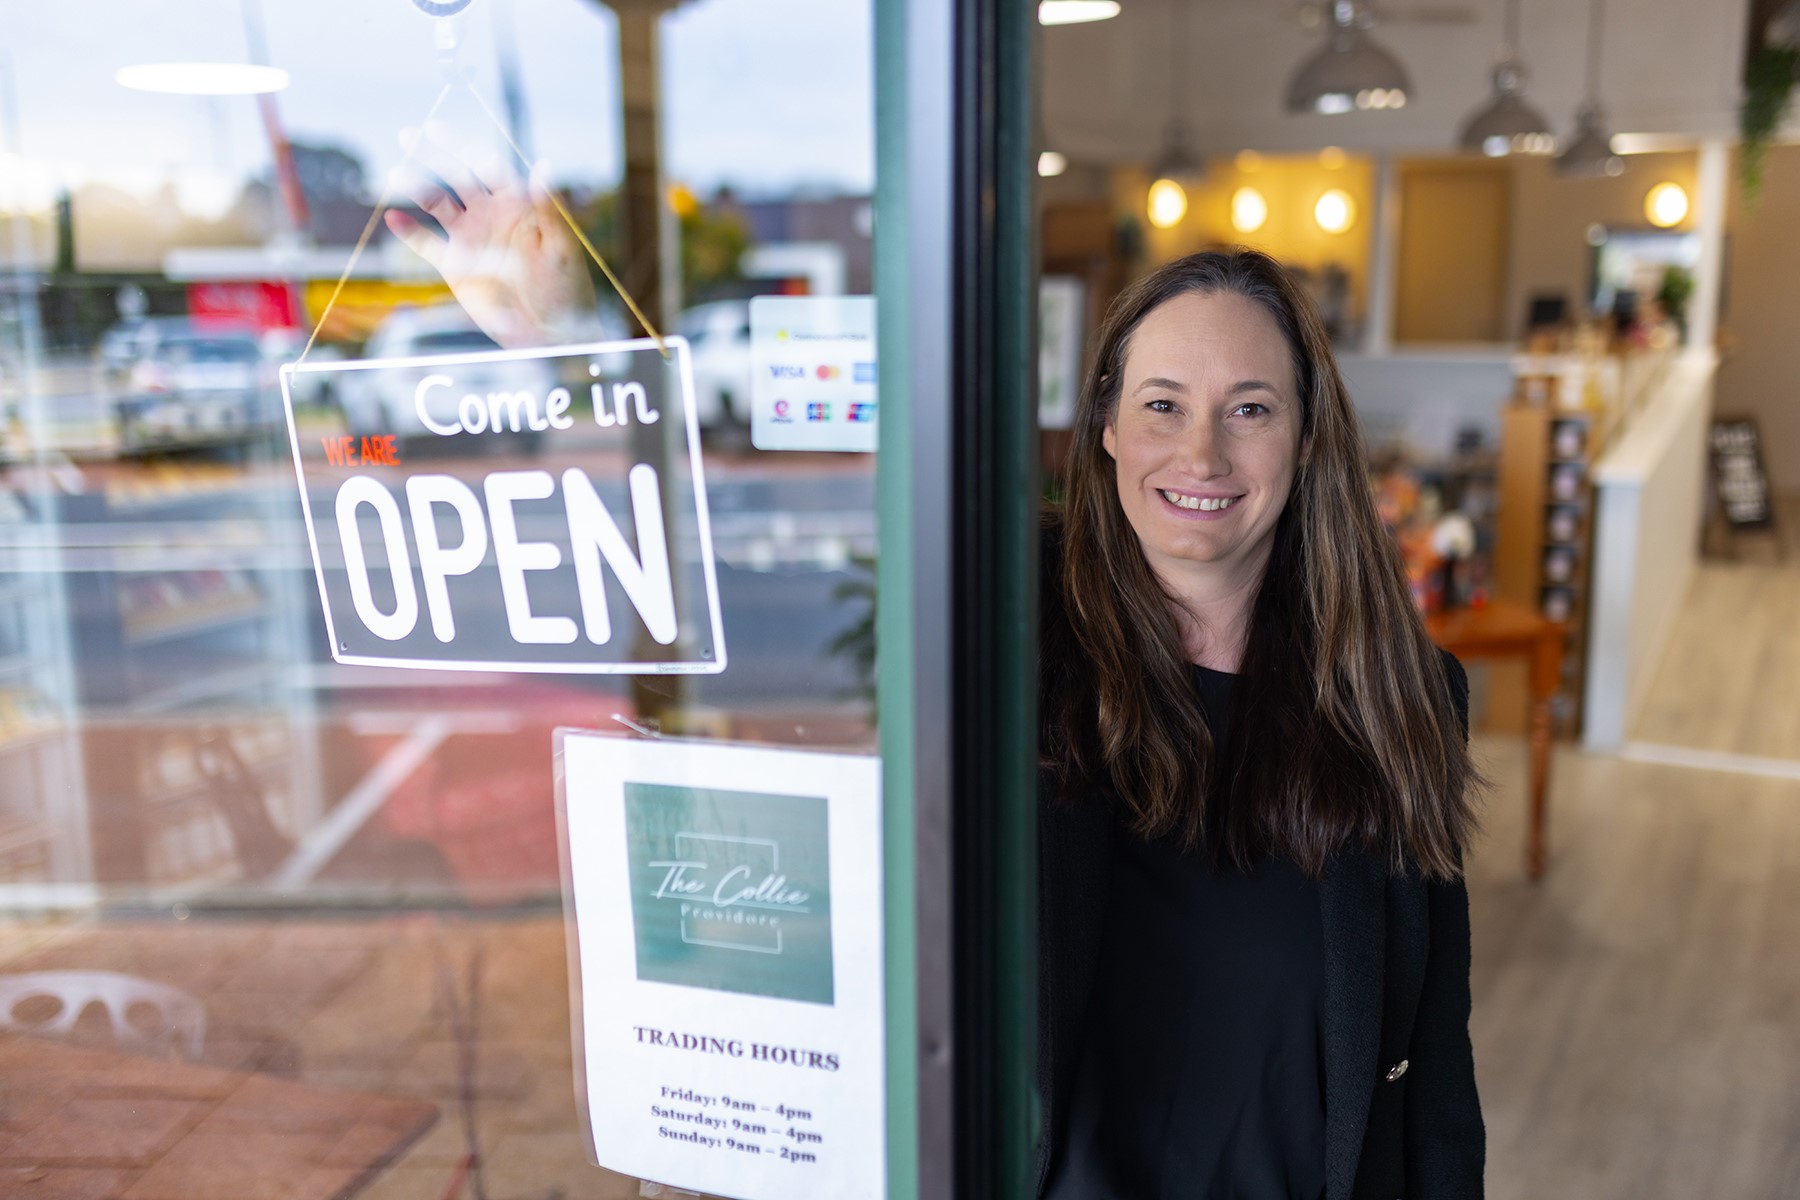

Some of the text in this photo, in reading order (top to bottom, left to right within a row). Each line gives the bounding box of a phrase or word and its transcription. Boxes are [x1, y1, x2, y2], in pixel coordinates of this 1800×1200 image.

[414, 363, 660, 436] Come in
[321, 434, 401, 467] WE ARE
[335, 463, 678, 646] OPEN
[648, 861, 811, 907] The Collie
[633, 1026, 841, 1072] TRADING HOURS
[651, 1105, 727, 1130] Saturday:
[731, 1119, 767, 1135] 9am
[786, 1127, 823, 1144] 4pm
[660, 1086, 717, 1107] Friday:
[721, 1096, 756, 1112] 9am
[775, 1104, 812, 1121] 4pm
[658, 1126, 722, 1148] Sunday:
[726, 1138, 761, 1154] 9am
[780, 1146, 817, 1163] 2pm
